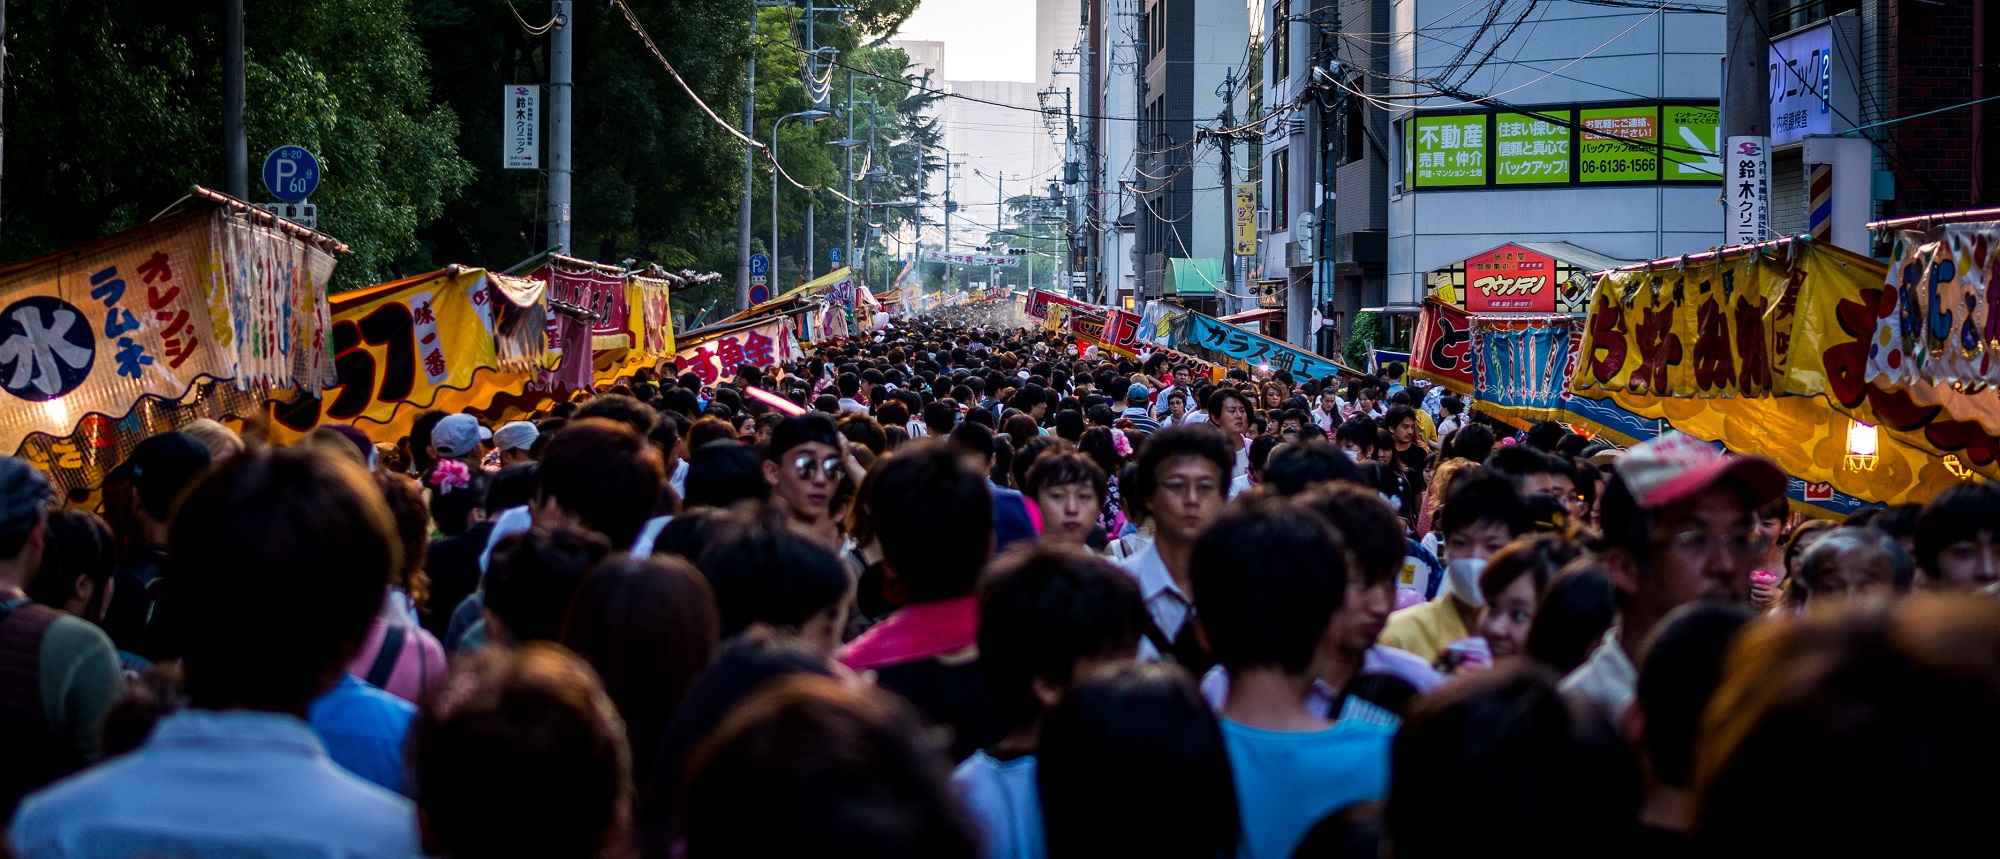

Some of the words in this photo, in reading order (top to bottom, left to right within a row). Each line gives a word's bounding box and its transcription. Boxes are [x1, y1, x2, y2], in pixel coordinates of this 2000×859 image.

[1822, 54, 1829, 110] 2F
[516, 97, 526, 154] 鈴木クリニック
[1419, 124, 1483, 150] 不動産
[1498, 121, 1568, 137] 住まい探しを
[282, 150, 302, 158] 8-20
[1419, 150, 1483, 168] 売買・仲介
[1498, 140, 1568, 156] 信頼と真心で
[277, 159, 297, 192] P
[1499, 159, 1568, 175] バックアップ!
[1582, 158, 1656, 173] 06-6136-1566
[290, 178, 306, 193] 60
[753, 259, 761, 273] P
[1473, 274, 1546, 297] マウンテン
[90, 265, 154, 379] ラムネ
[137, 251, 198, 369] オレンジ
[0, 305, 93, 395] 水
[414, 301, 446, 377] 味一番
[1205, 325, 1315, 380] ガラス細工
